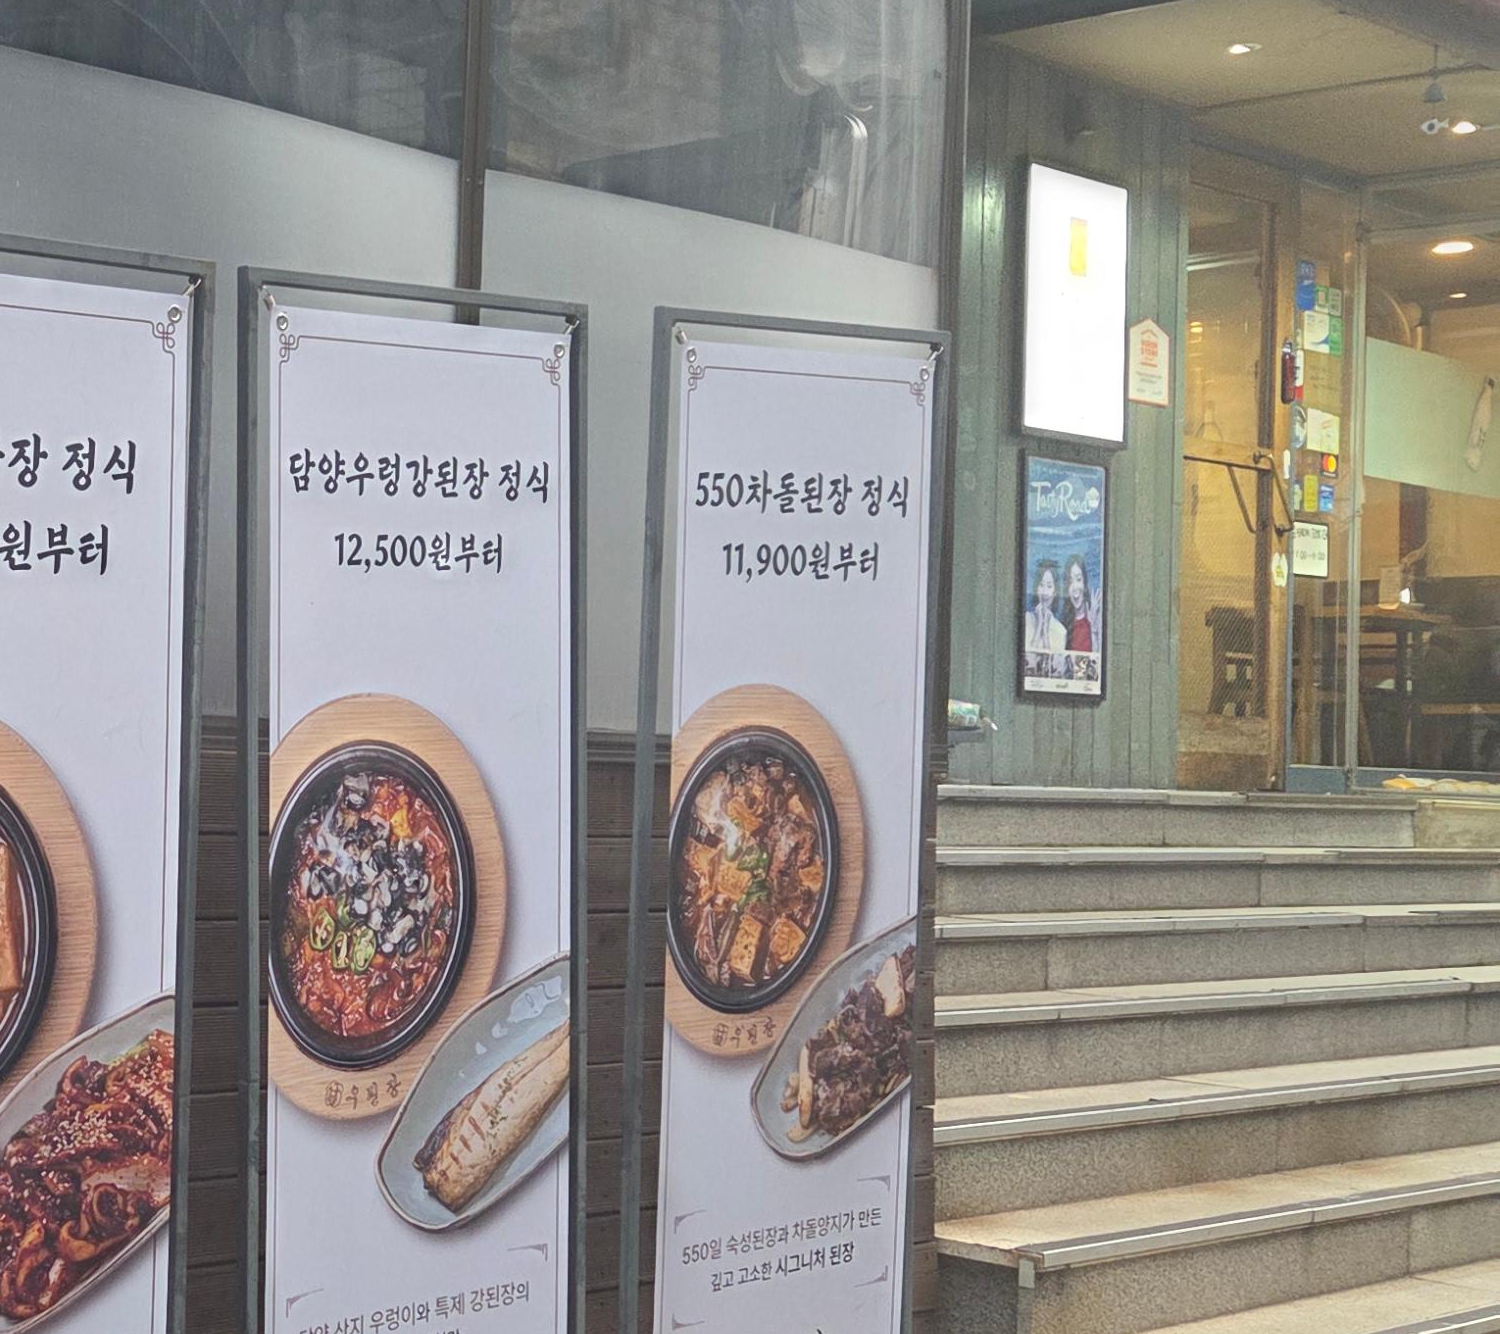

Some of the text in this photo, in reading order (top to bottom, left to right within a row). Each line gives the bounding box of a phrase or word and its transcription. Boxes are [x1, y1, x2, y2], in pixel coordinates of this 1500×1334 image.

[61, 436, 137, 495] 정식
[288, 447, 550, 504] 담양우렁강된장 정식
[695, 469, 910, 518] 550차돌된장 정식
[334, 531, 504, 574] 12,500원부터
[722, 540, 880, 583] 11,900원부터
[682, 1207, 882, 1266] 550일 숙성된장과 차돌양지가 만든
[710, 1241, 855, 1293] 깊고 고소한 시그니처 된장
[369, 1301, 431, 1333] 우렁이와
[434, 1291, 466, 1317] 특제
[469, 1280, 531, 1313] 강된장의
